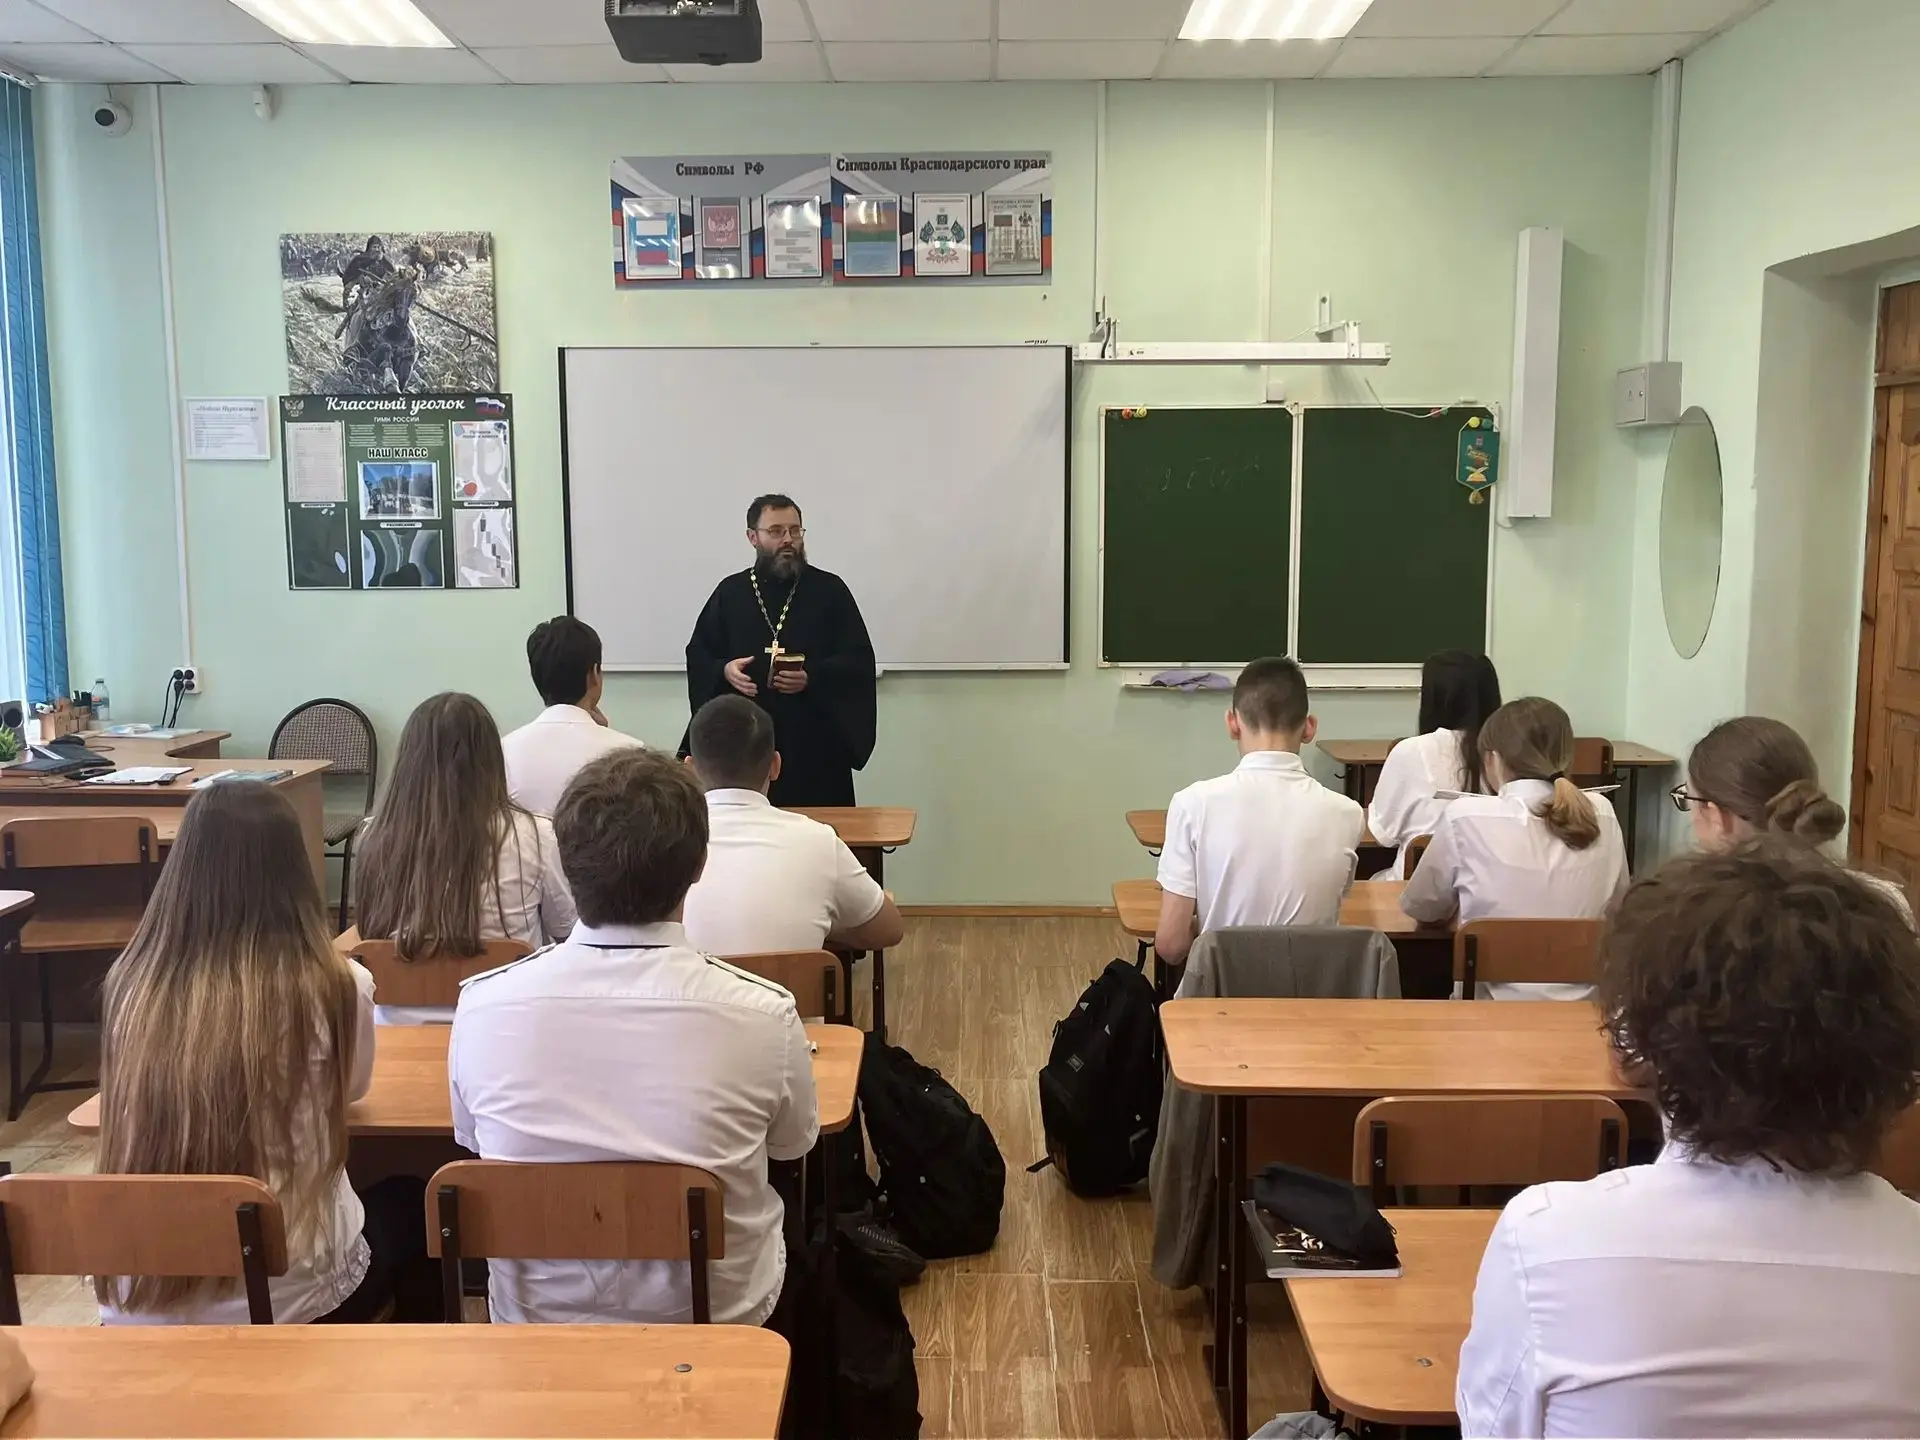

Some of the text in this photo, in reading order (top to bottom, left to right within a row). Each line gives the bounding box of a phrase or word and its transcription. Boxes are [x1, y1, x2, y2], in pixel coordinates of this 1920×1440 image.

[675, 161, 764, 176] Символы РФ
[836, 157, 1046, 173] Символы Краснодарского края
[325, 396, 466, 415] Классный уголок
[368, 447, 428, 458] НАШ КЛАСС
